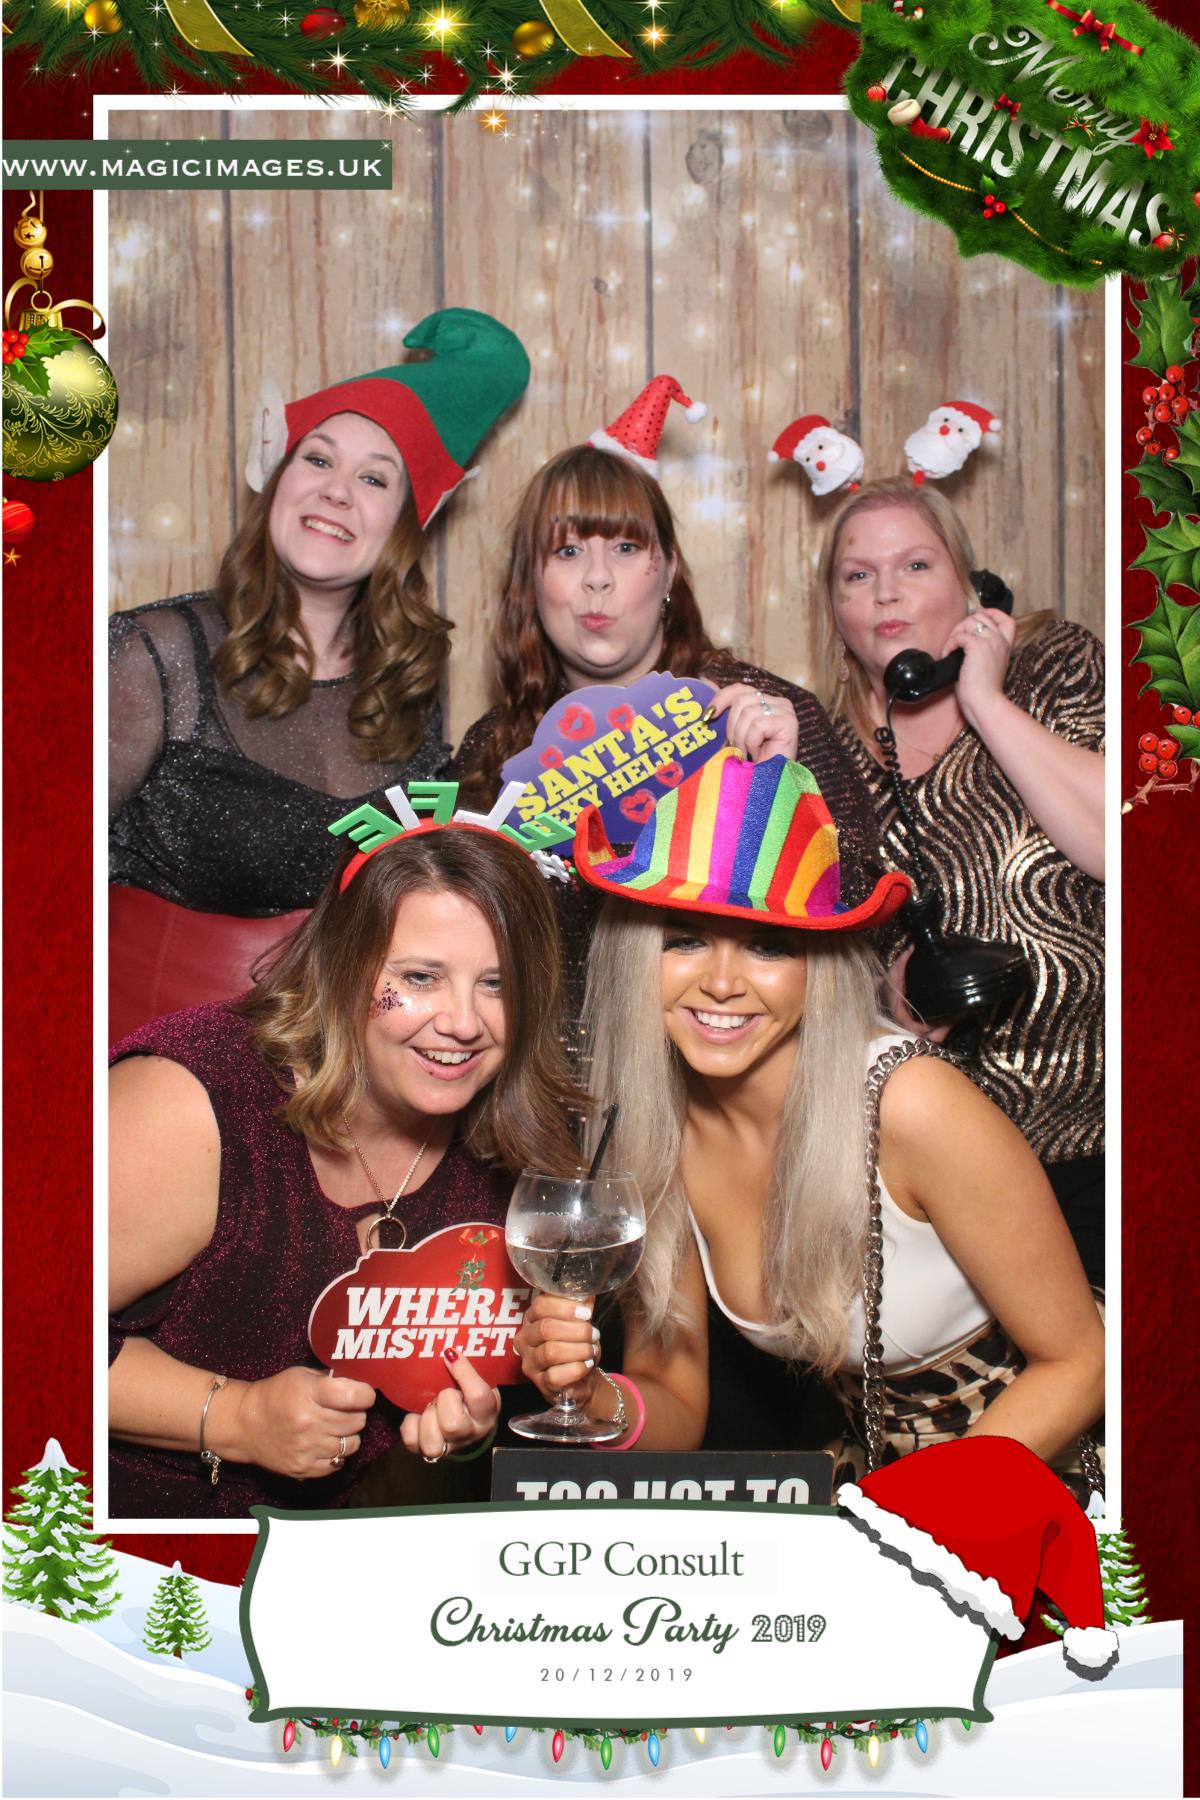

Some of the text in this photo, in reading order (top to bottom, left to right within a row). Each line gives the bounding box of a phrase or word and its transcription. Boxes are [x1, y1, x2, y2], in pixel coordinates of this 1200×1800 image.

[515, 686, 703, 822] SANTA'S
[601, 719, 718, 798] HELPER
[331, 1327, 520, 1360] MISTLET
